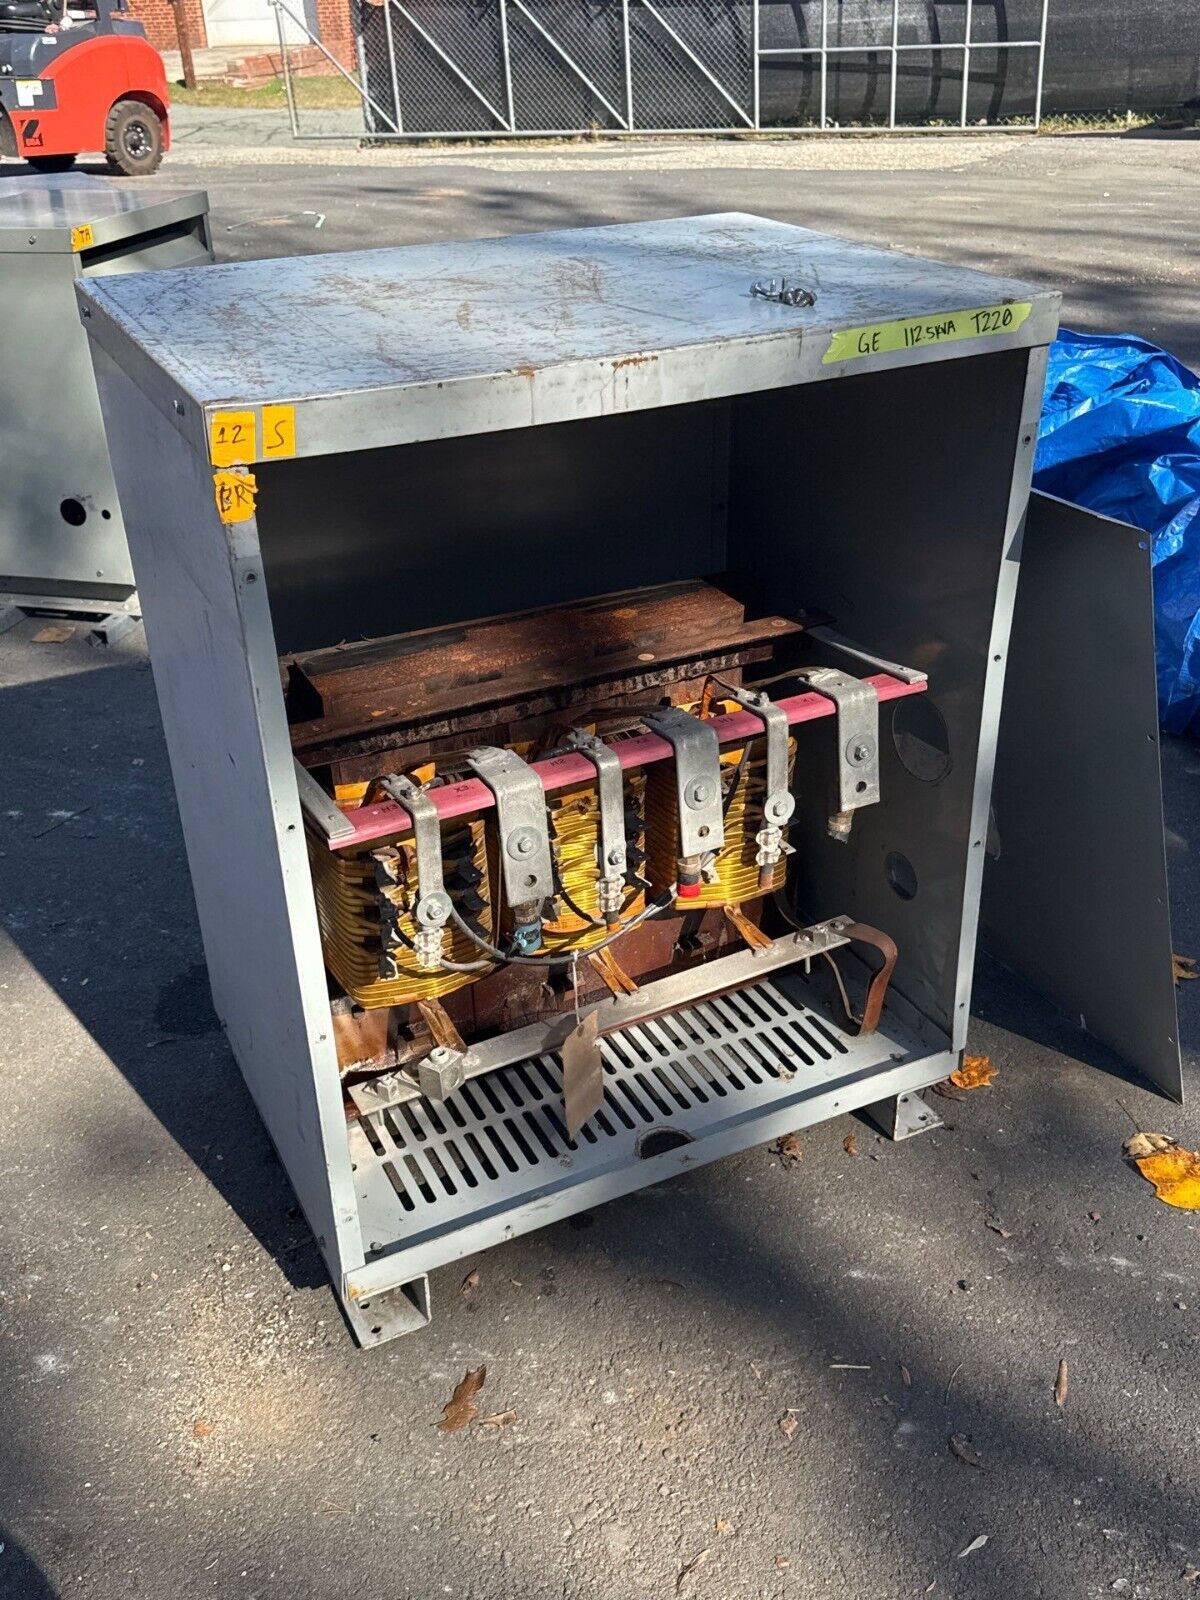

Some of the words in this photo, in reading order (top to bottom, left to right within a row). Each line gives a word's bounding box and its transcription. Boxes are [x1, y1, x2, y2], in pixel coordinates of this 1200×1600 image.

[857, 333, 881, 354] GE
[971, 308, 1013, 335] T220
[216, 424, 246, 444] 12
[381, 803, 399, 814] H3
